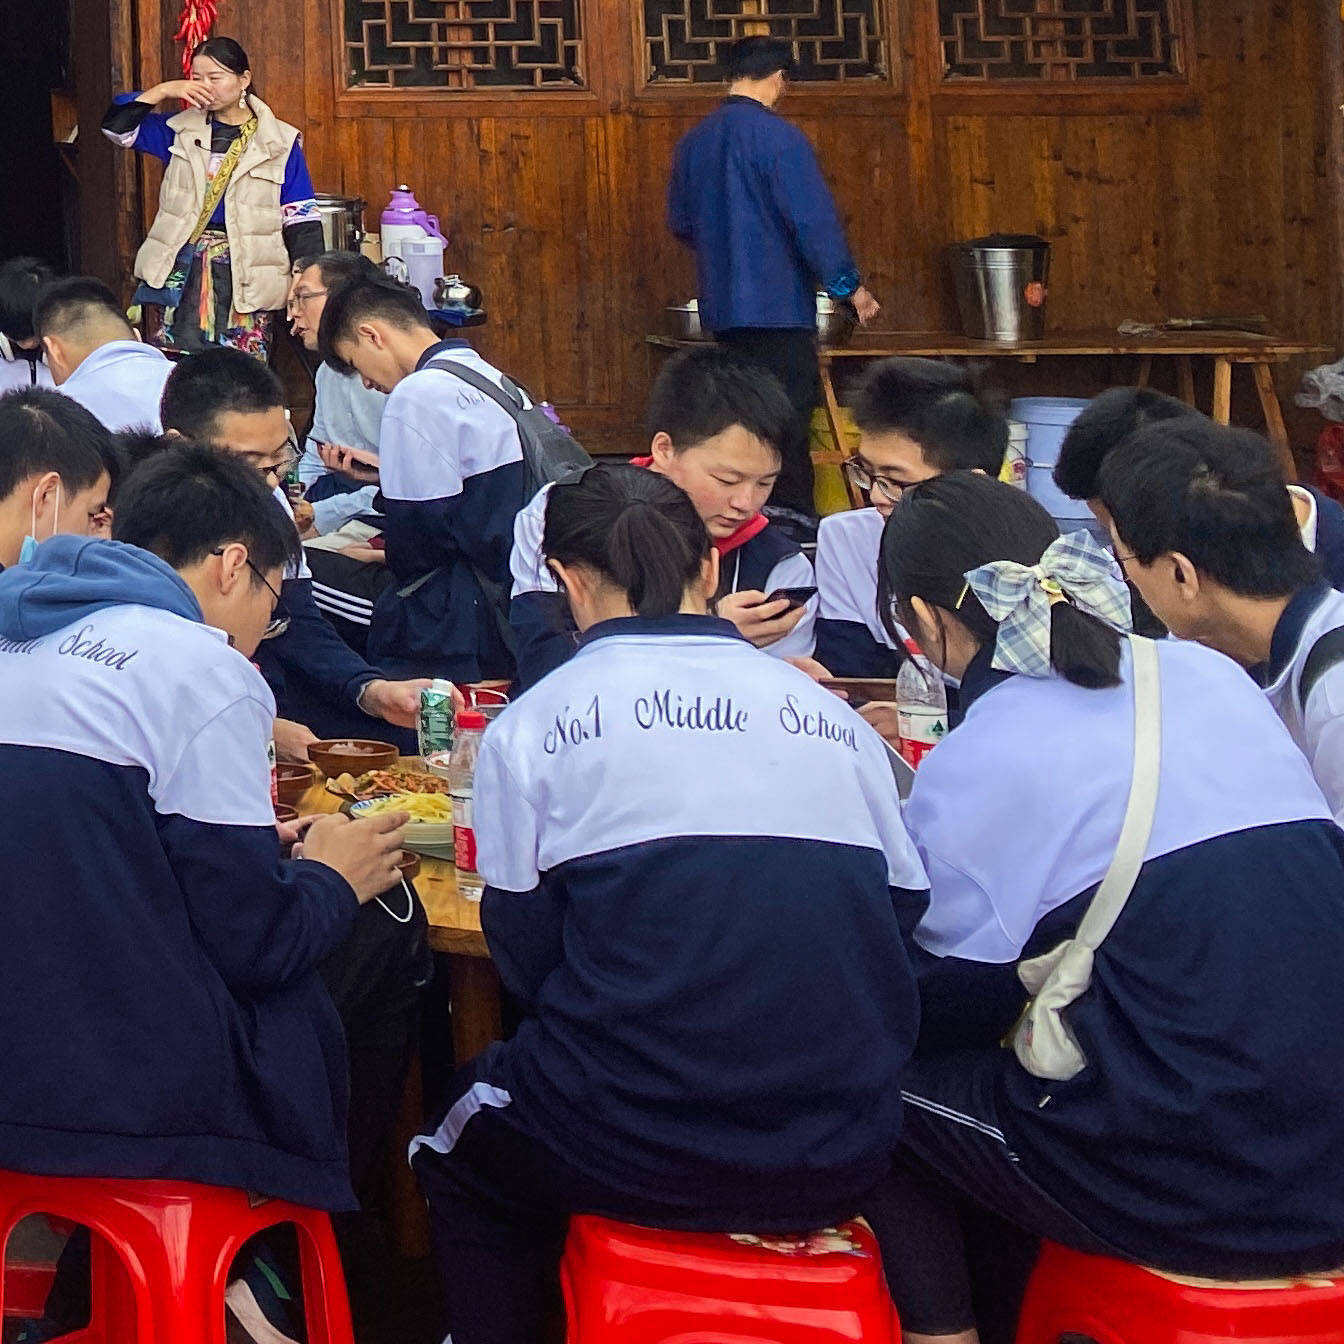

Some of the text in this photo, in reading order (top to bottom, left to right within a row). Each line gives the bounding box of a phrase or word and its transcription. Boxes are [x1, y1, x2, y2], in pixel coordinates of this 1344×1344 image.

[57, 623, 139, 671] School
[543, 688, 861, 754] No.1 Middle School
